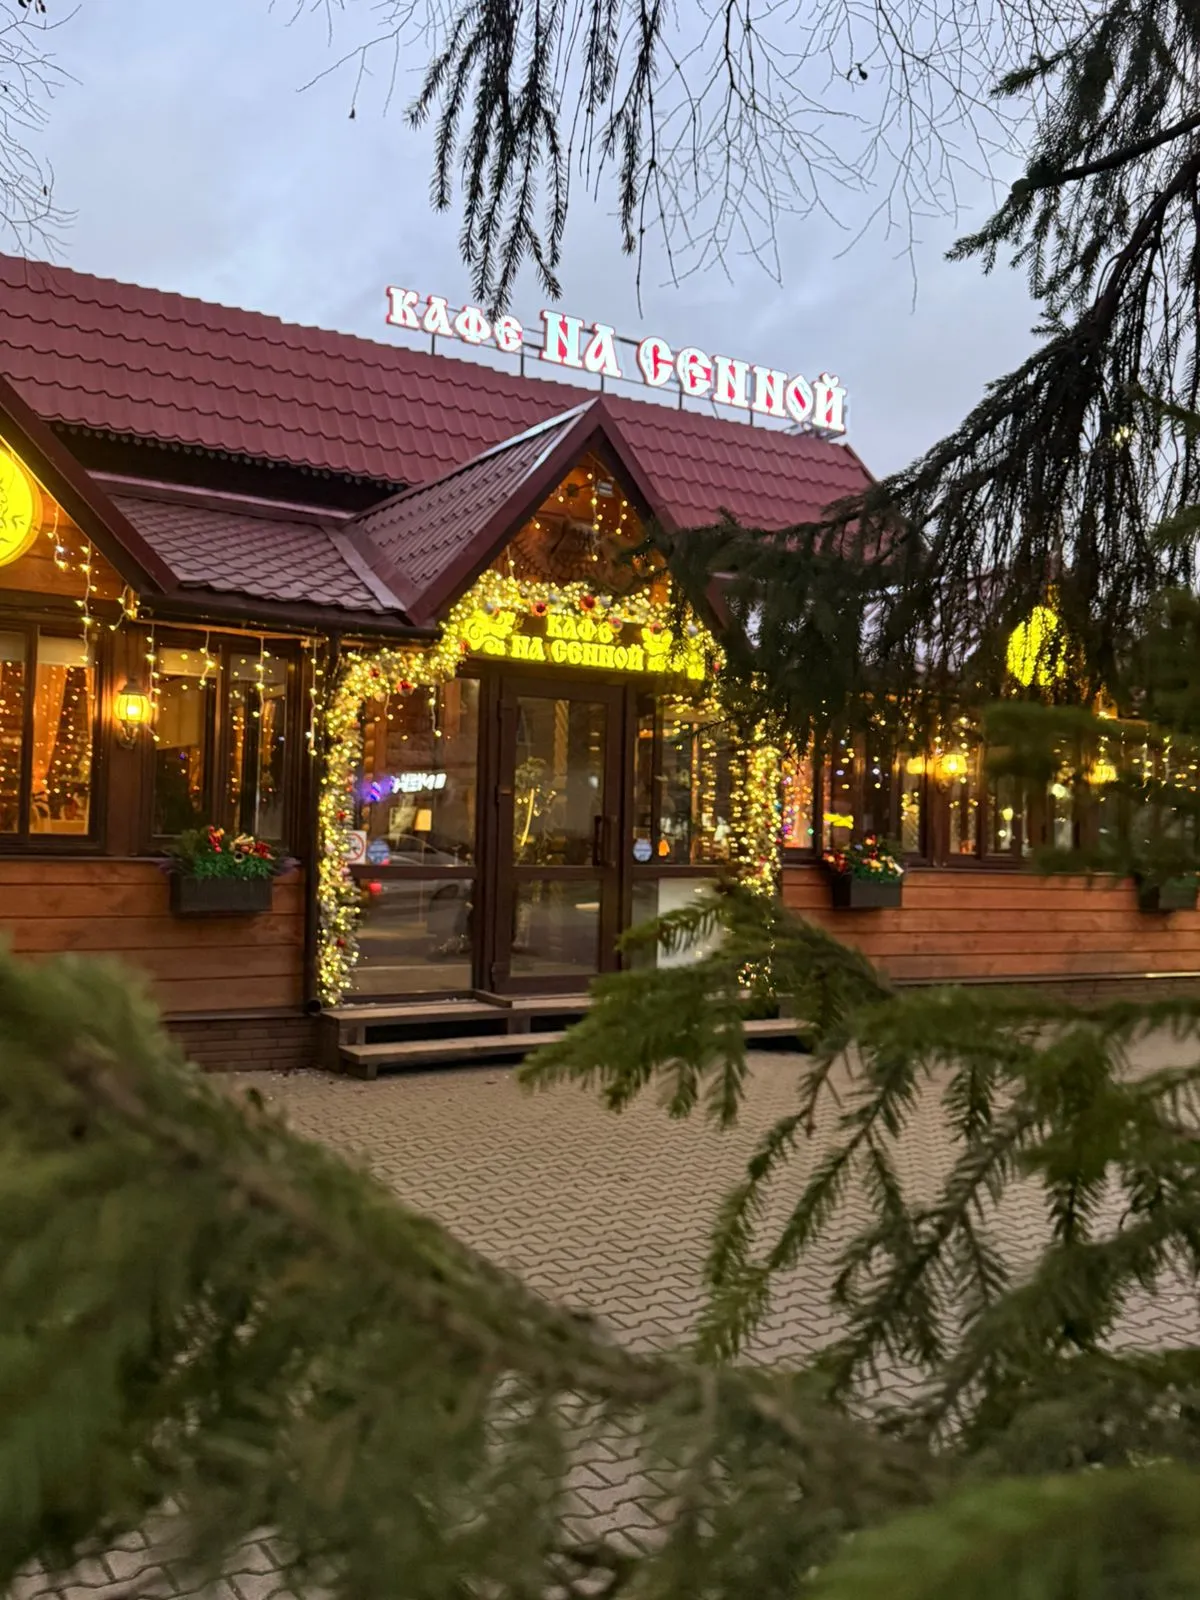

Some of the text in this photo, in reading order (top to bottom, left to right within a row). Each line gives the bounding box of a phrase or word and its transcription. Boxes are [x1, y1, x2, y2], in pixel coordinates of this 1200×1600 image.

[385, 286, 847, 433] КАФЕ НА СЕННОЙ
[547, 615, 613, 643] КАФЕ
[512, 635, 644, 671] НА СЕННОЙ
